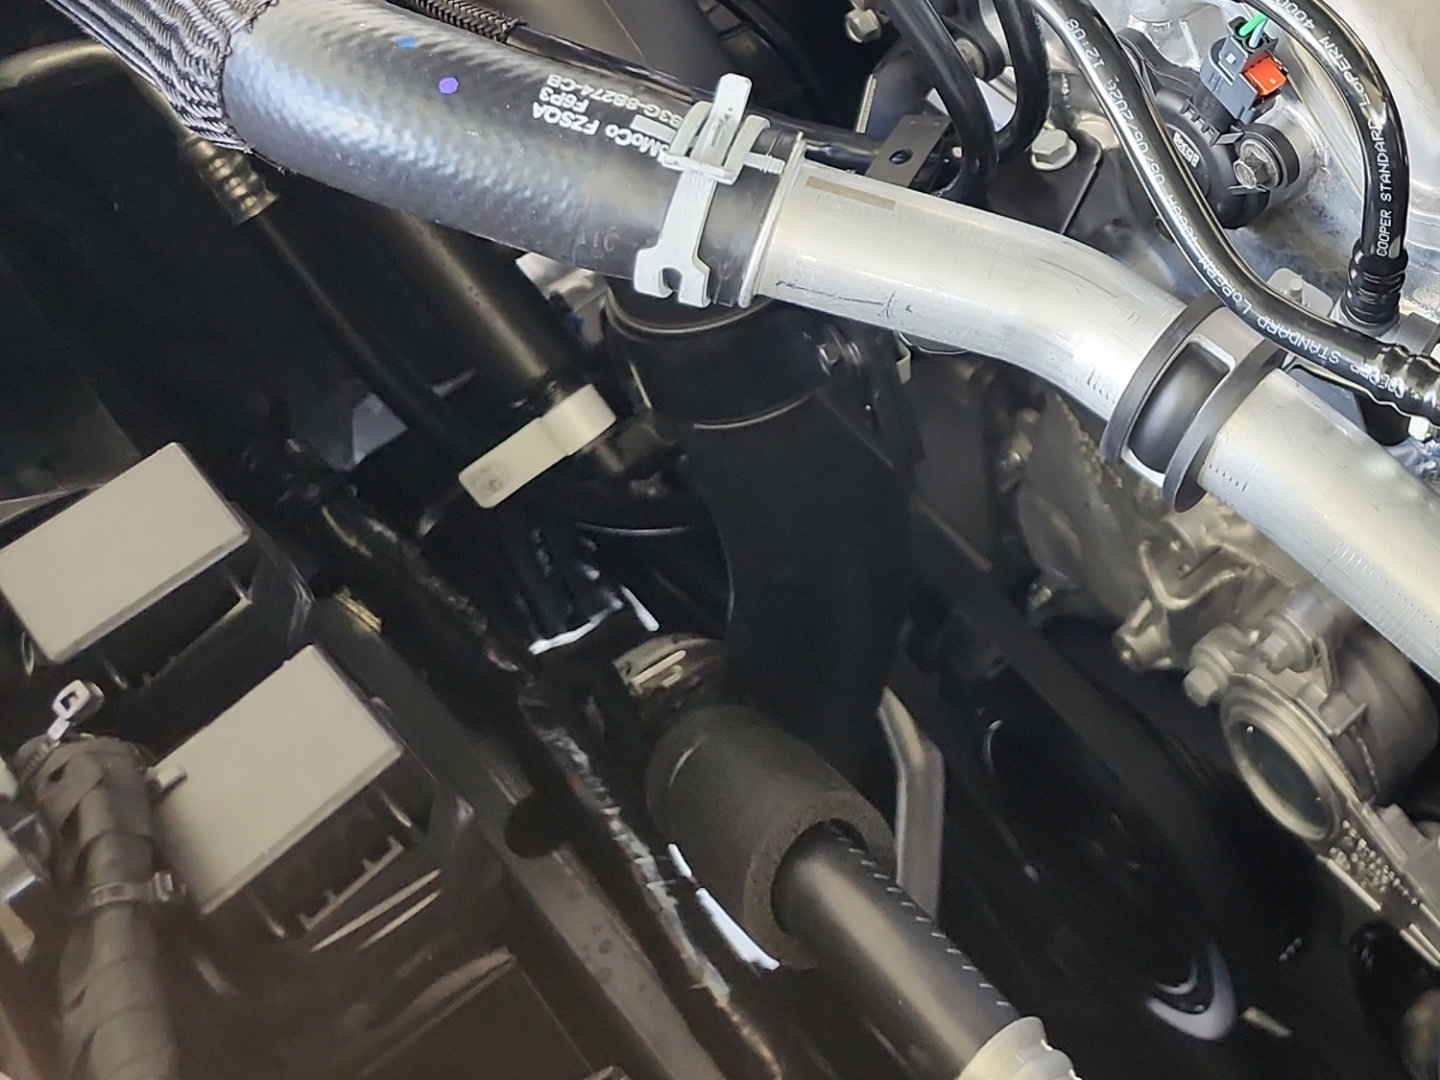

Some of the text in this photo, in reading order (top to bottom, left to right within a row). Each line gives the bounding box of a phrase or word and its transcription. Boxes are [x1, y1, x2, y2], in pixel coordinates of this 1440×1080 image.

[1065, 18, 1105, 69] 12:08
[1318, 35, 1369, 106] LoPERM
[537, 84, 591, 115] F6P3
[529, 100, 670, 162] oMoCo FZSQA
[1368, 117, 1393, 203] STANDARD
[1375, 209, 1393, 258] COOPER
[1193, 252, 1255, 316] LoPERM
[1254, 313, 1344, 364] STANDARD
